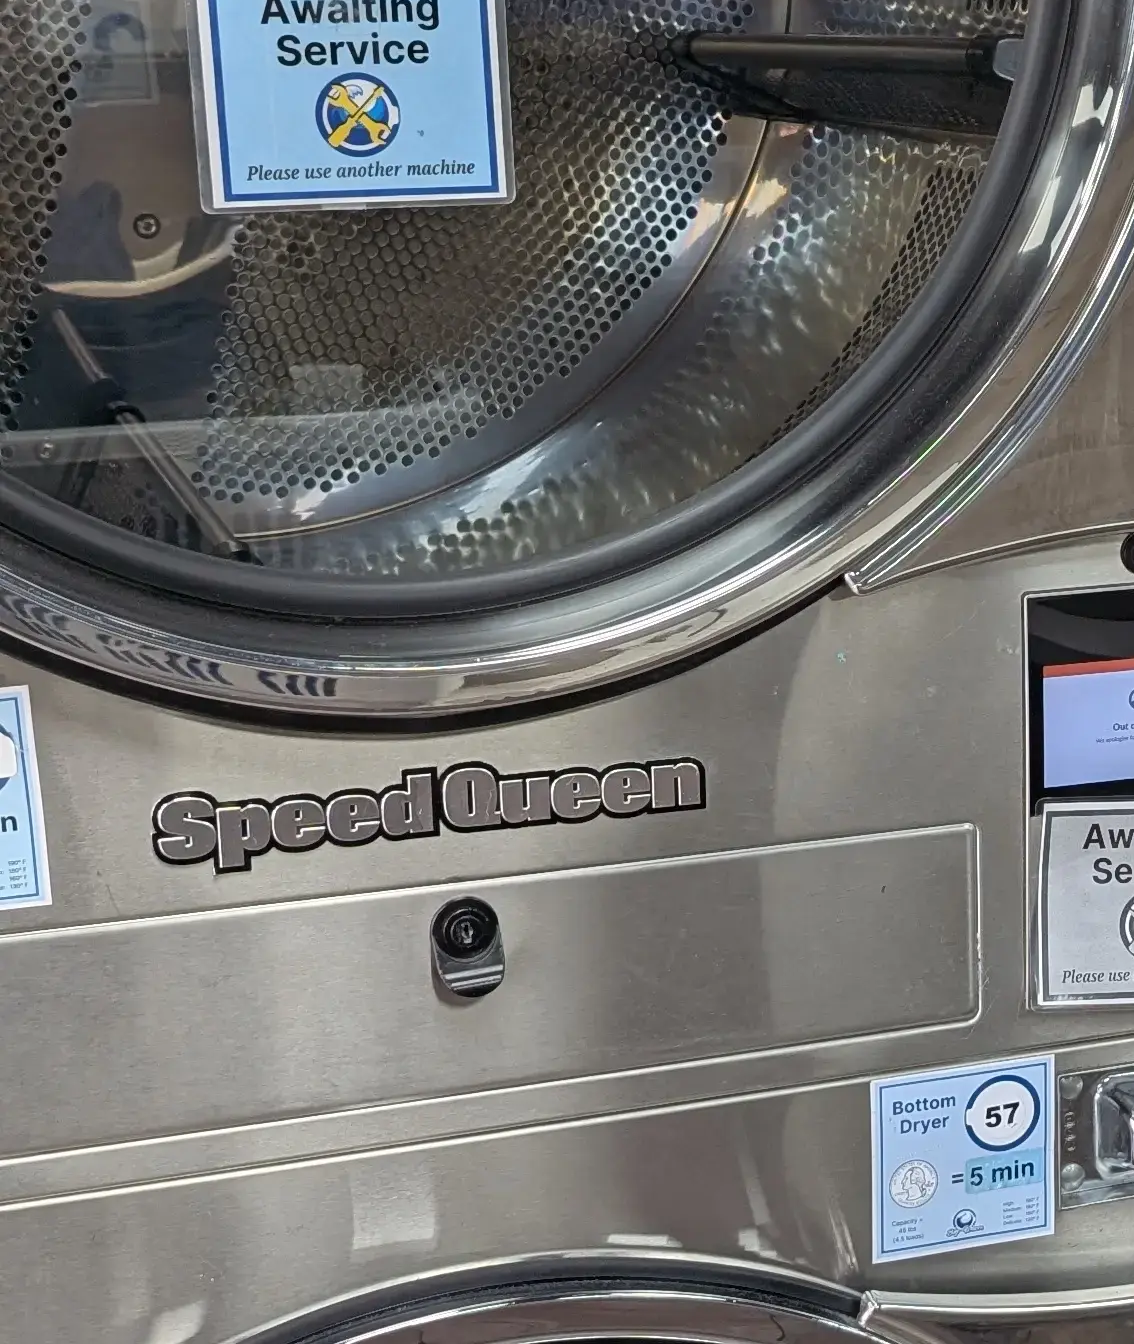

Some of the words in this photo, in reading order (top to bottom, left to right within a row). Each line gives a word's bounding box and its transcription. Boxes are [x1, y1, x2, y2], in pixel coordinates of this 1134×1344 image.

[276, 32, 430, 67] Service
[247, 164, 300, 181] Please
[305, 166, 332, 180] use
[336, 161, 402, 178] another
[407, 159, 476, 176] machine
[1113, 723, 1129, 731] Out
[152, 765, 441, 876] Speed
[438, 756, 707, 833] Queen
[1062, 969, 1105, 984] Please
[1108, 970, 1130, 982] use
[892, 1095, 956, 1116] Bottom
[985, 1101, 1021, 1129] 57
[900, 1114, 950, 1135] Dryer
[970, 1166, 984, 1187] 5
[991, 1159, 1035, 1183] min
[891, 1218, 918, 1227] Capacity
